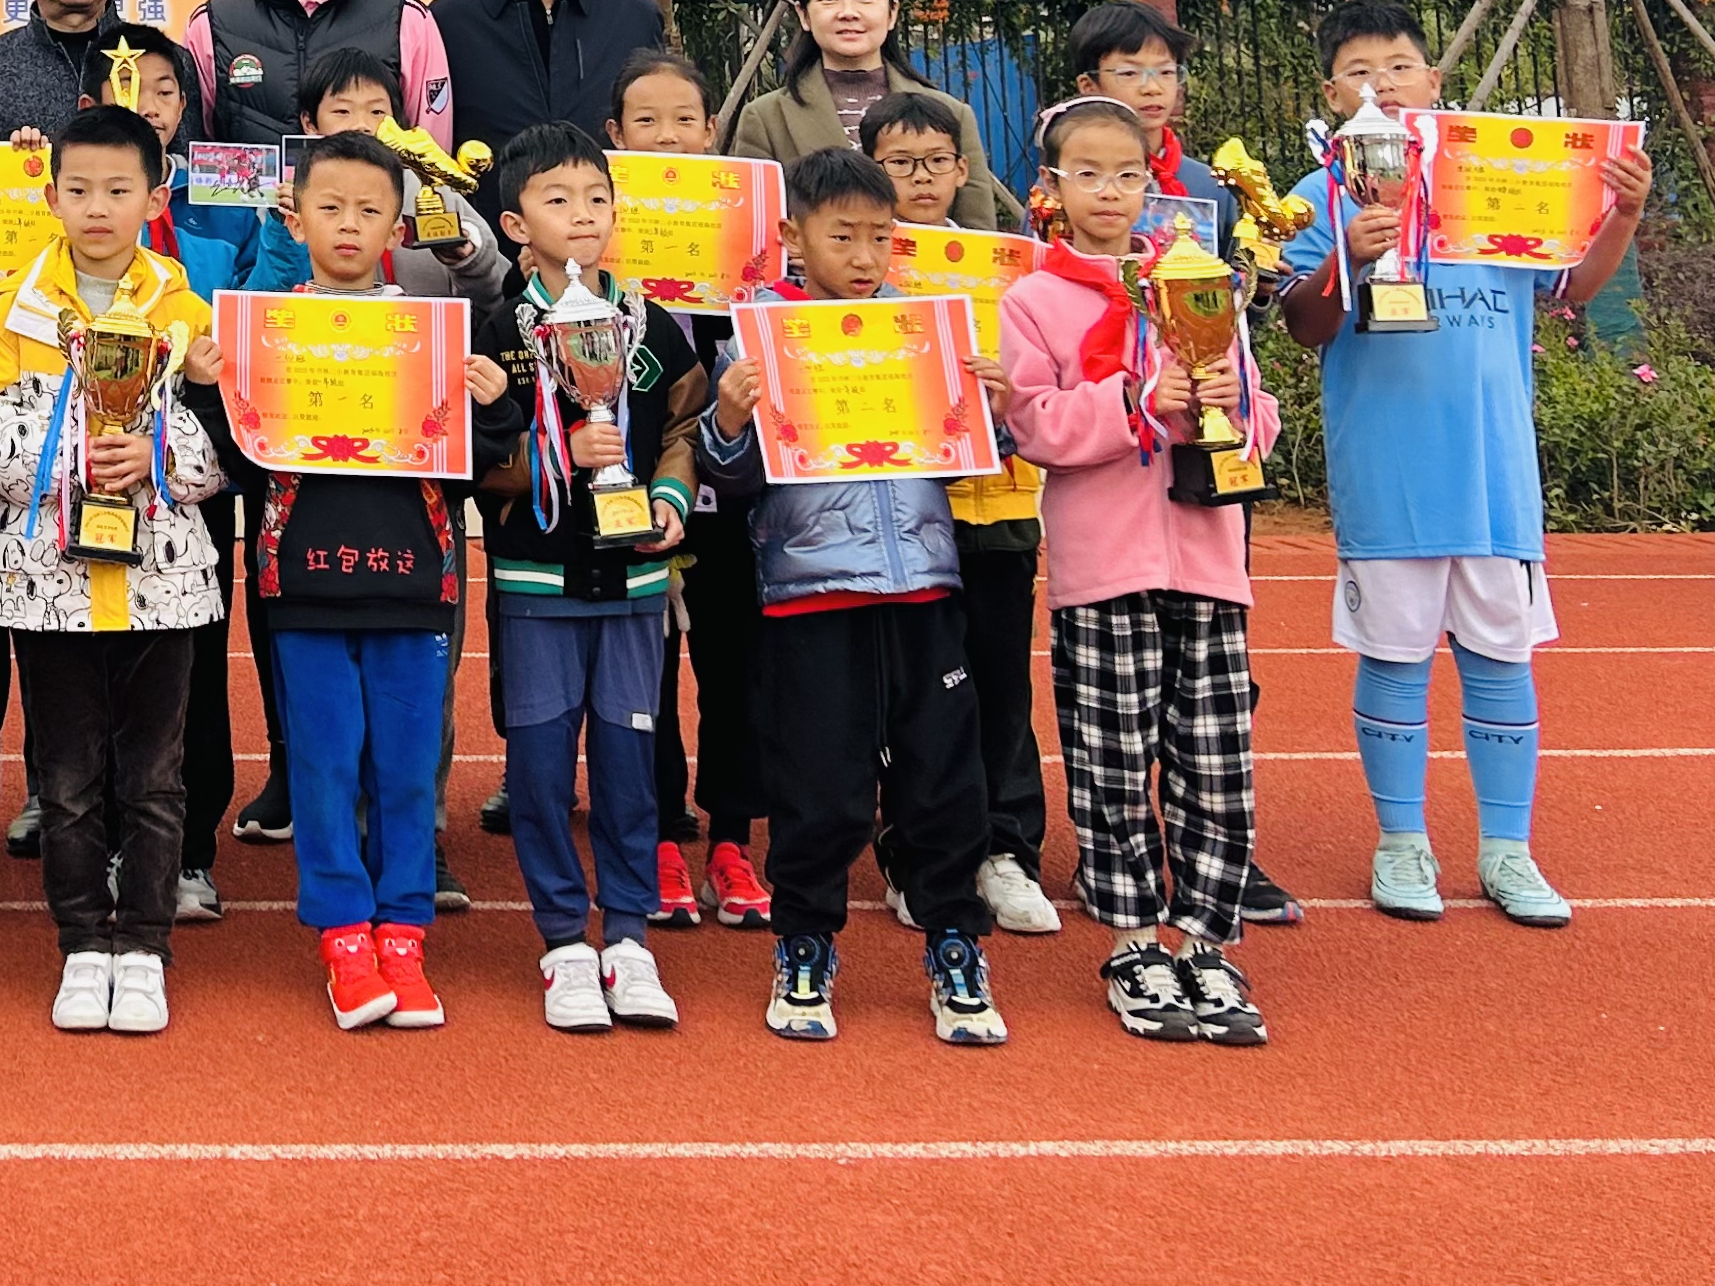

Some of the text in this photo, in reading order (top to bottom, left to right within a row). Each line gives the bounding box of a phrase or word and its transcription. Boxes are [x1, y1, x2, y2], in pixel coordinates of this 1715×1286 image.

[640, 239, 700, 257] 第一名
[308, 391, 374, 410] 第一名
[306, 545, 416, 574] 红包放这
[1361, 726, 1415, 743] CITY
[1468, 729, 1525, 745] CITY
